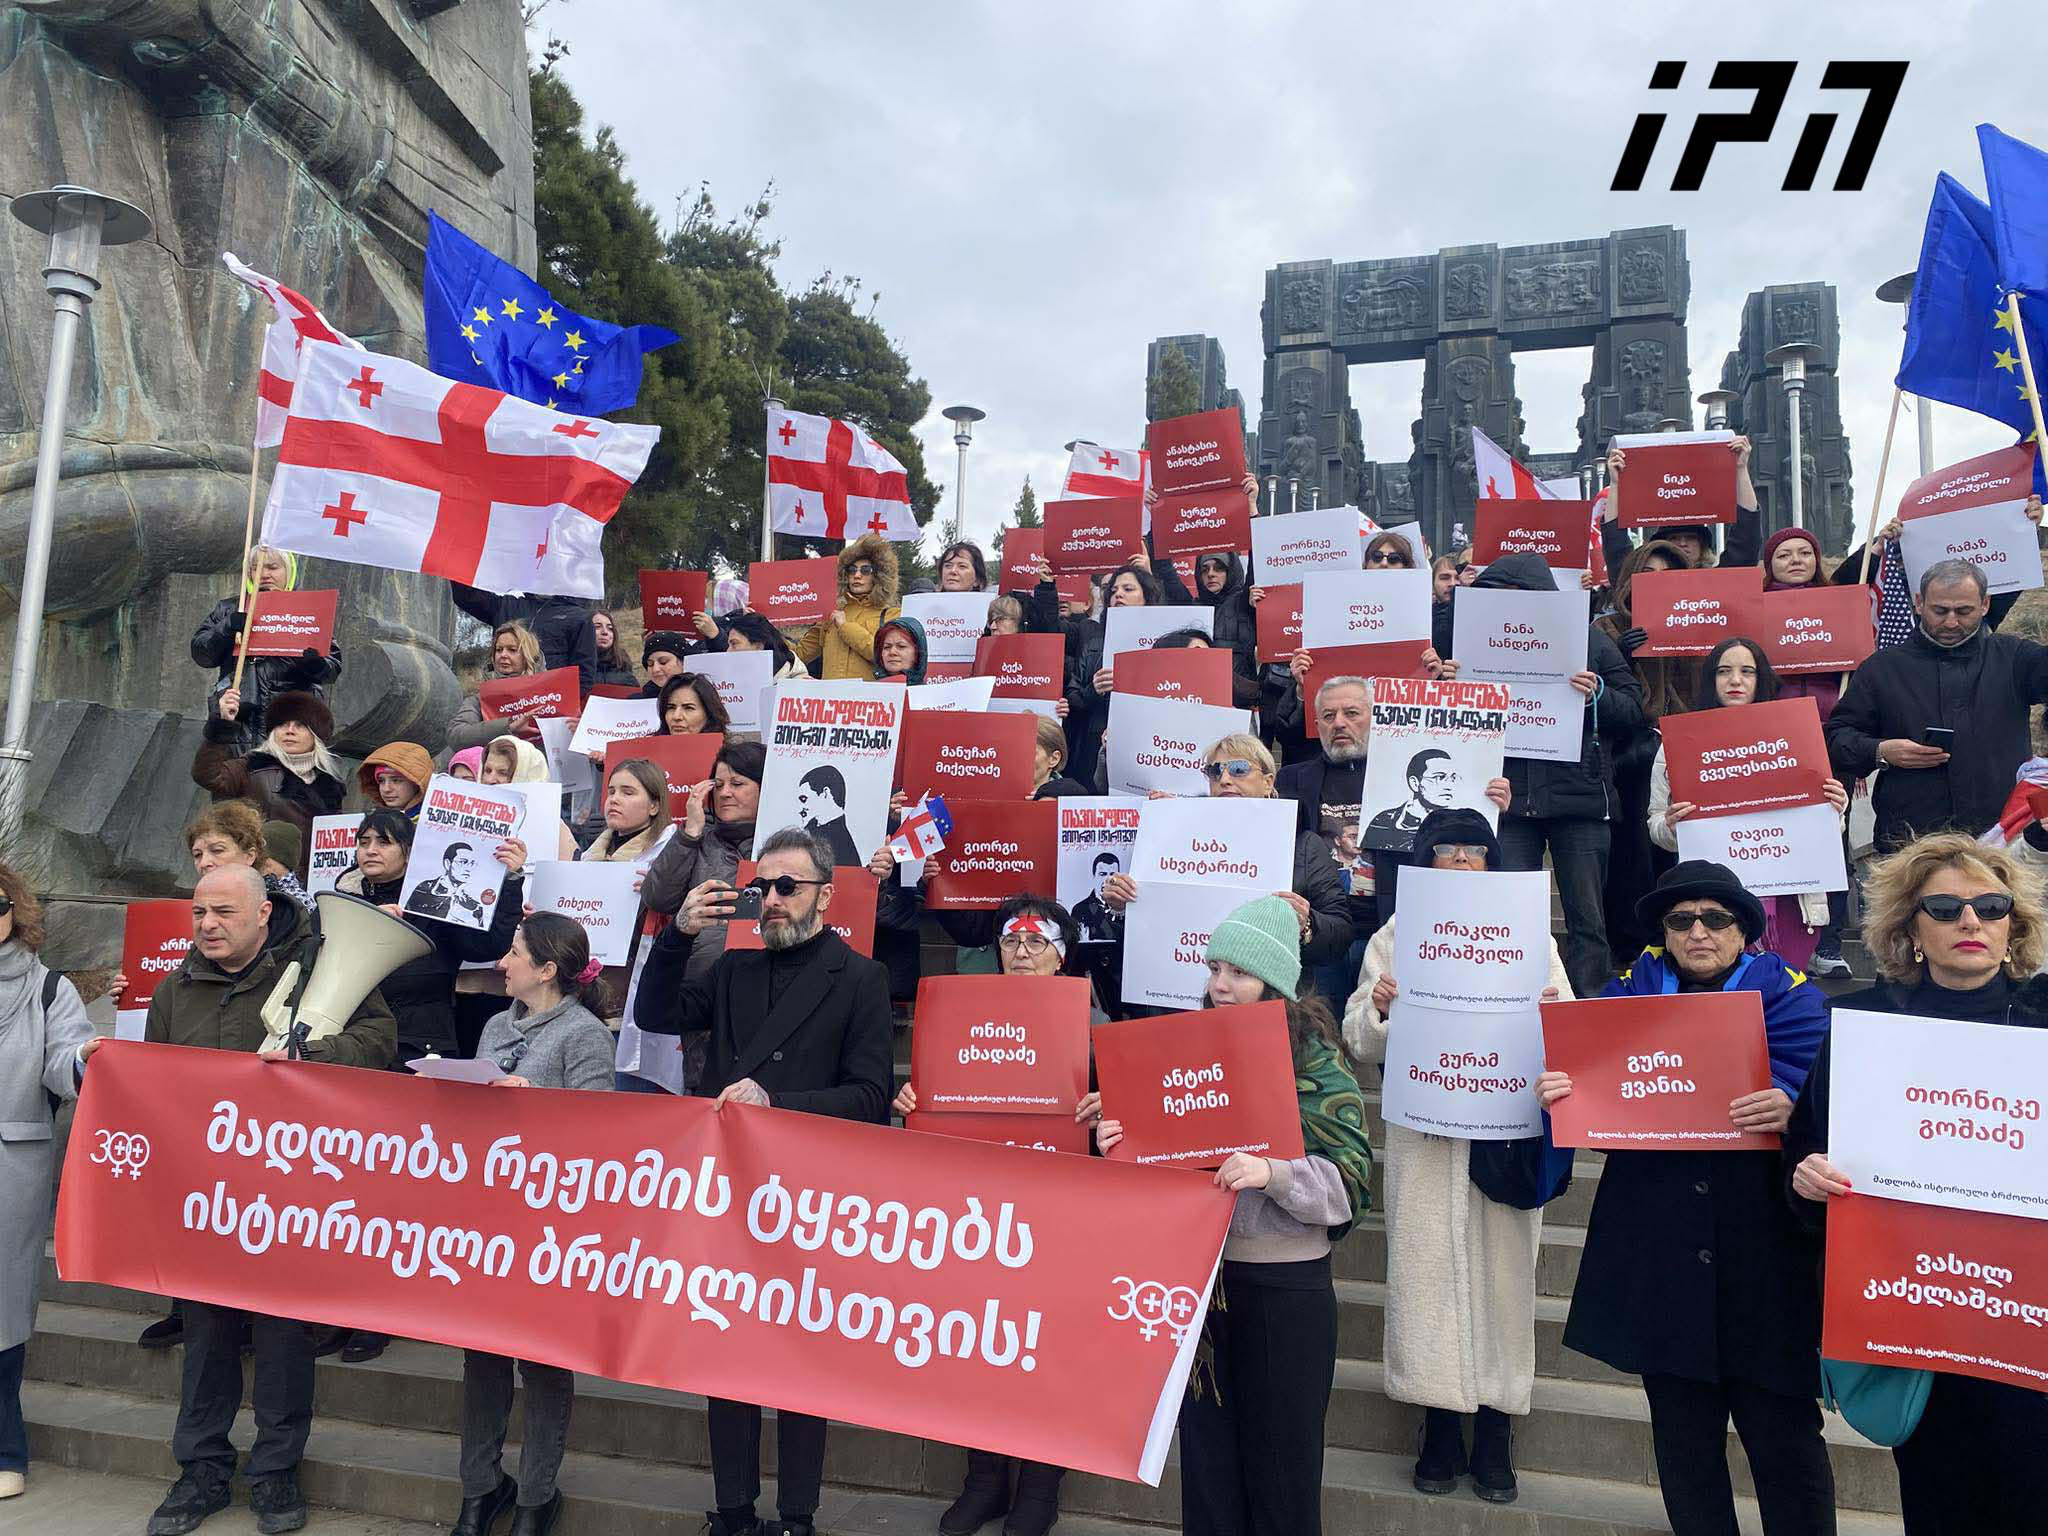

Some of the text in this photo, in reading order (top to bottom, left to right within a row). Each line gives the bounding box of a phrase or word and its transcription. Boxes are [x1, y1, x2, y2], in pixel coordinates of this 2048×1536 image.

[1166, 440, 1217, 457] ანასტასია
[1166, 453, 1221, 469] ზინოვკინა
[1663, 474, 1690, 485] ნიკა
[1657, 487, 1696, 499] მელია
[1180, 506, 1217, 519] სერგეი
[1072, 526, 1110, 538] გიორგი
[1173, 518, 1226, 533] კუხარჩუკი
[1508, 529, 1555, 541] ირაკლი
[1280, 538, 1331, 552] თორნიკე
[1500, 541, 1561, 553] ჩხვირკვია
[1946, 538, 1988, 554] რამაზ
[1266, 549, 1348, 567] მჭედლიშვილი
[778, 582, 810, 593] თემურ
[768, 592, 818, 605] ქურციკიძე
[1673, 599, 1720, 612] ანდრო
[1349, 604, 1384, 614] ლუკა
[259, 613, 316, 624] ავთანდილ
[926, 617, 965, 627] ირაკლი
[1348, 618, 1384, 630] ჯაბუა
[1666, 613, 1728, 627] ჭიჭინაძე
[1785, 618, 1823, 630] რეზო
[1503, 623, 1534, 635] ნანა
[1488, 637, 1549, 651] სანდერი
[1778, 629, 1832, 646] კიკნაძე
[1001, 661, 1023, 673] ბექა
[1156, 680, 1181, 691] აბო
[1152, 735, 1197, 754] ზვიად
[1701, 738, 1789, 764] ვლადიმერ
[941, 745, 997, 761] მანუჩარ
[935, 762, 1001, 778] მიქელაძე
[1136, 752, 1205, 772] ცეცხლაძ
[1699, 756, 1798, 783] გველესიანი
[1730, 827, 1784, 842] დავით
[964, 840, 1019, 856] გიორგი
[1191, 838, 1228, 853] საბა
[1728, 843, 1790, 860] სტურუა
[950, 859, 1034, 873] ტერიშვილი
[1159, 857, 1258, 878] სხვიტარიძე
[557, 896, 603, 911] მიხეილ
[1433, 920, 1510, 941] ირაკლი
[1419, 941, 1524, 965] ქერაშვილი
[970, 1022, 1026, 1042] ონისე
[958, 1045, 1036, 1066] ცხადაძე
[1439, 1053, 1499, 1069] გურამ
[1627, 1051, 1683, 1073] გური
[1162, 1062, 1224, 1089] ანტონ
[1409, 1065, 1527, 1093] მირცხულავა
[1620, 1076, 1696, 1099] ჟვანია
[1163, 1089, 1230, 1116] ჩეჩინი
[1905, 1086, 2041, 1121] თორნიკე
[1919, 1118, 2025, 1150] გოშაძე
[206, 1100, 1034, 1270] მადლობა რეჟიმის ტყვეებს
[1924, 1182, 1989, 1198] ისტორიული
[182, 1181, 1043, 1373] ისტორიული ბრძოლისთვის!
[1915, 1252, 2013, 1288] ვასილ
[1863, 1276, 2048, 1328] კაძელაშვილ
[1914, 1346, 1977, 1364] ისტორიული
